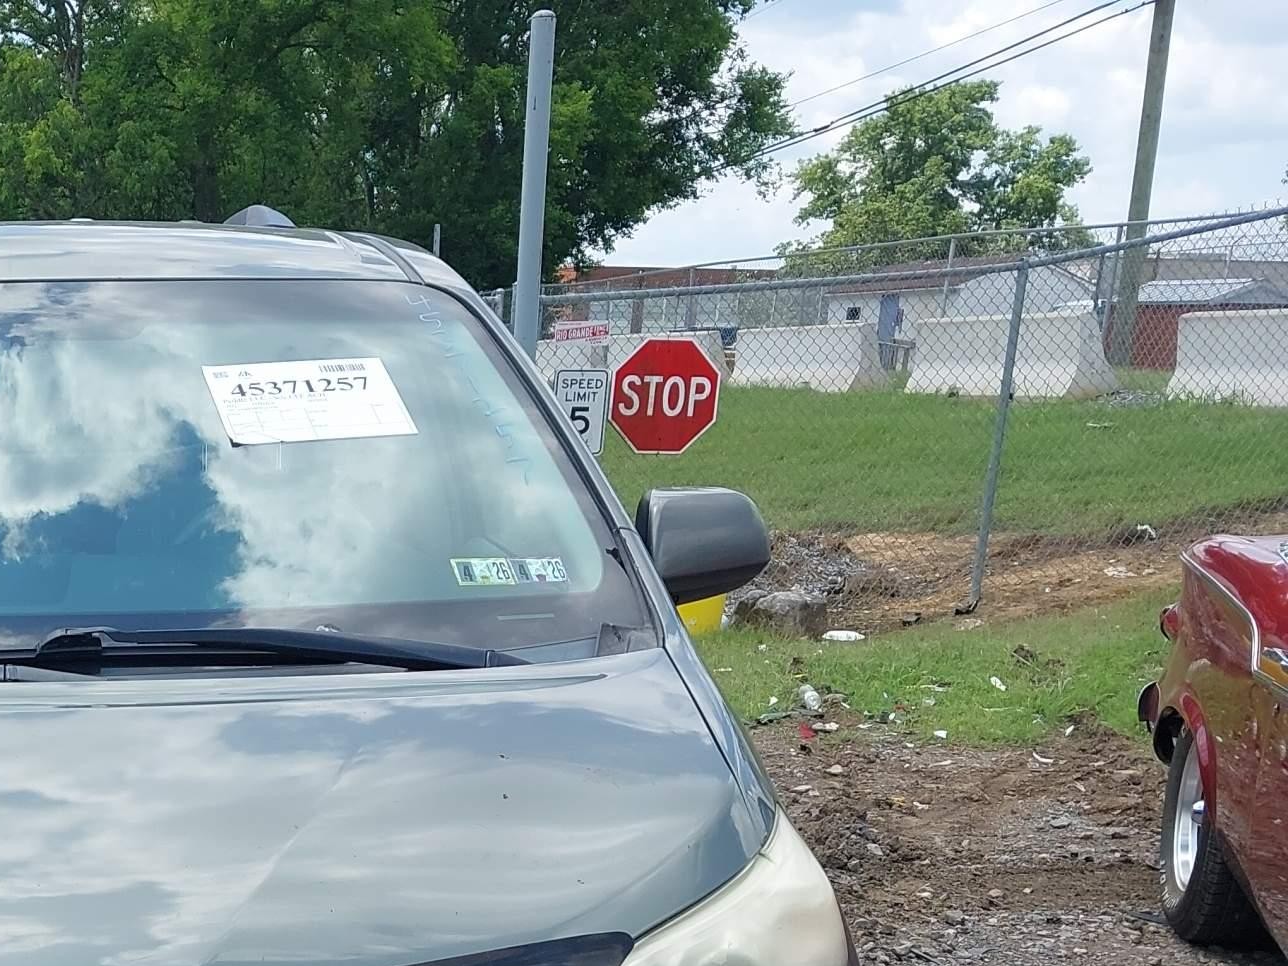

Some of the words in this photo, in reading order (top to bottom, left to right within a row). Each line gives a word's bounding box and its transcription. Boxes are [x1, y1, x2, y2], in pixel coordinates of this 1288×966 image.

[556, 330, 568, 341] RIO
[568, 326, 593, 339] GRANDE
[230, 376, 368, 397] 45371257
[561, 378, 604, 389] SPEED
[565, 391, 599, 402] LIMIT
[617, 375, 712, 417] STOP
[570, 406, 590, 435] 5
[463, 565, 473, 582] 4
[492, 562, 511, 581] 26
[518, 564, 529, 581] 4
[547, 560, 566, 579] 26
